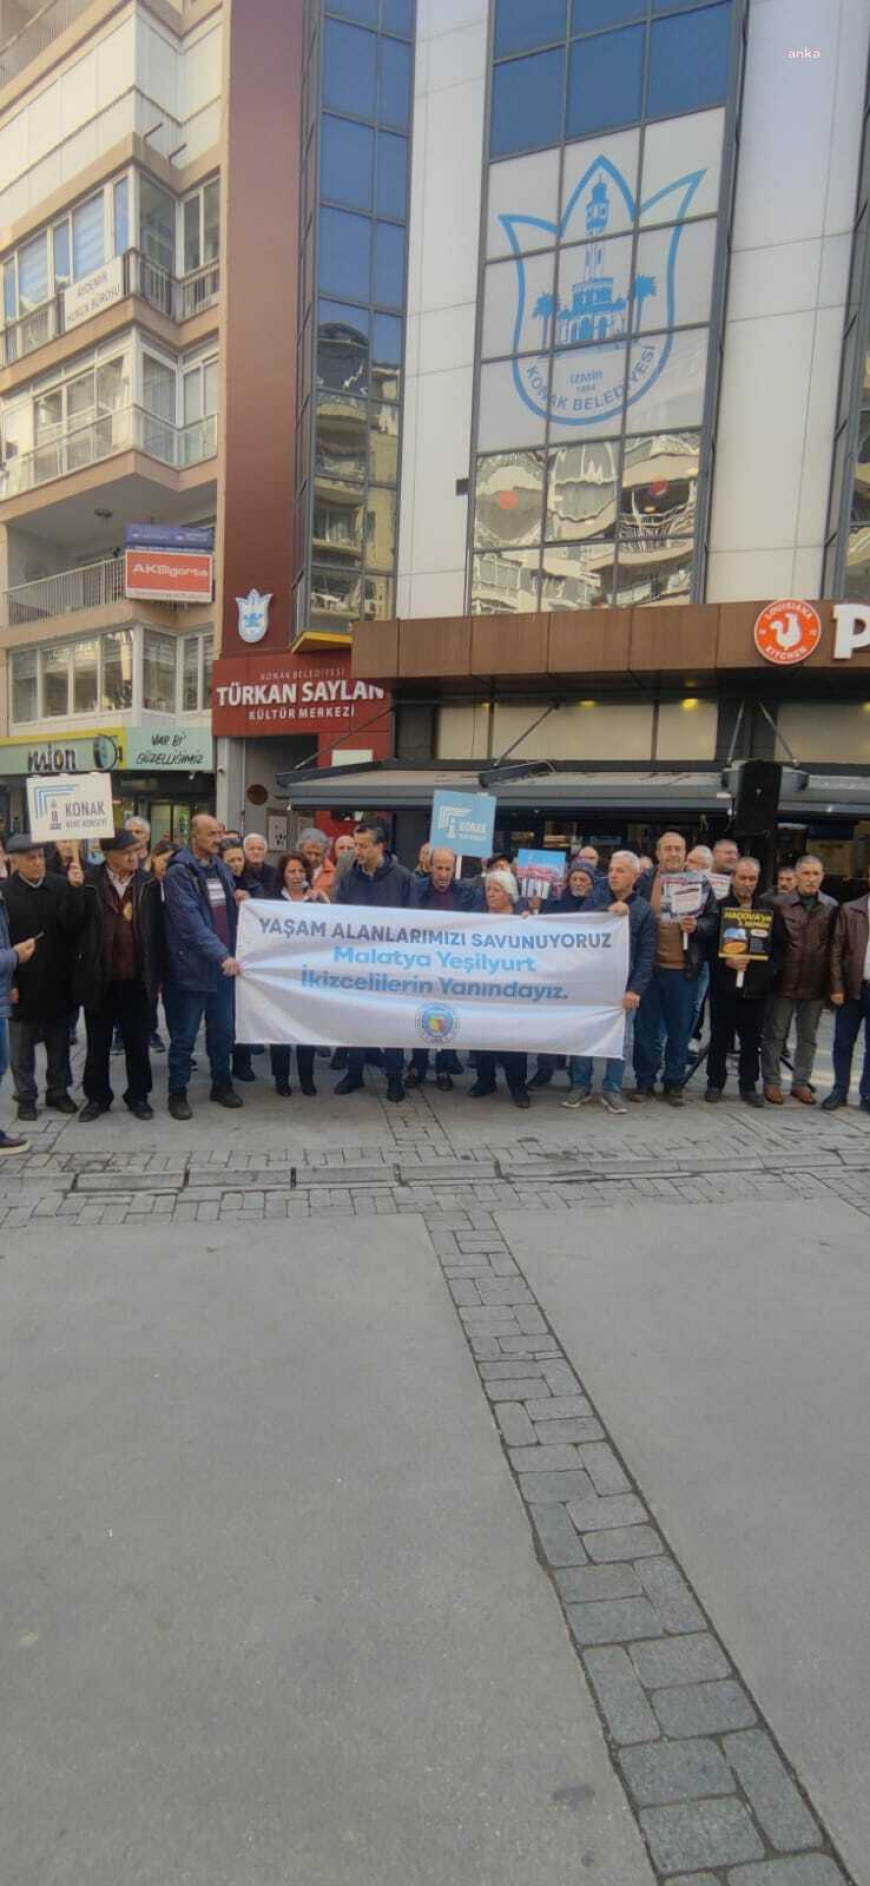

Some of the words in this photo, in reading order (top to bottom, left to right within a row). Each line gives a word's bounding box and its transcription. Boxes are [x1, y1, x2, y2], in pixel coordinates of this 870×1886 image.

[216, 682, 297, 707] TÜRKAN
[302, 679, 385, 703] SAYLAN
[249, 707, 296, 721] KÜLTÜR
[298, 705, 355, 719] MERKEZİ
[65, 801, 105, 817] KONAK
[259, 917, 326, 939] YAŞAM
[330, 922, 466, 946] ALANLARIMIZI
[471, 932, 612, 949] SAVUNUYORUZ
[333, 945, 431, 970] Malatya
[436, 950, 538, 977] Yeşilyurt
[301, 963, 433, 994] İkizcelilerin
[439, 976, 569, 1002] Yanındayız.
